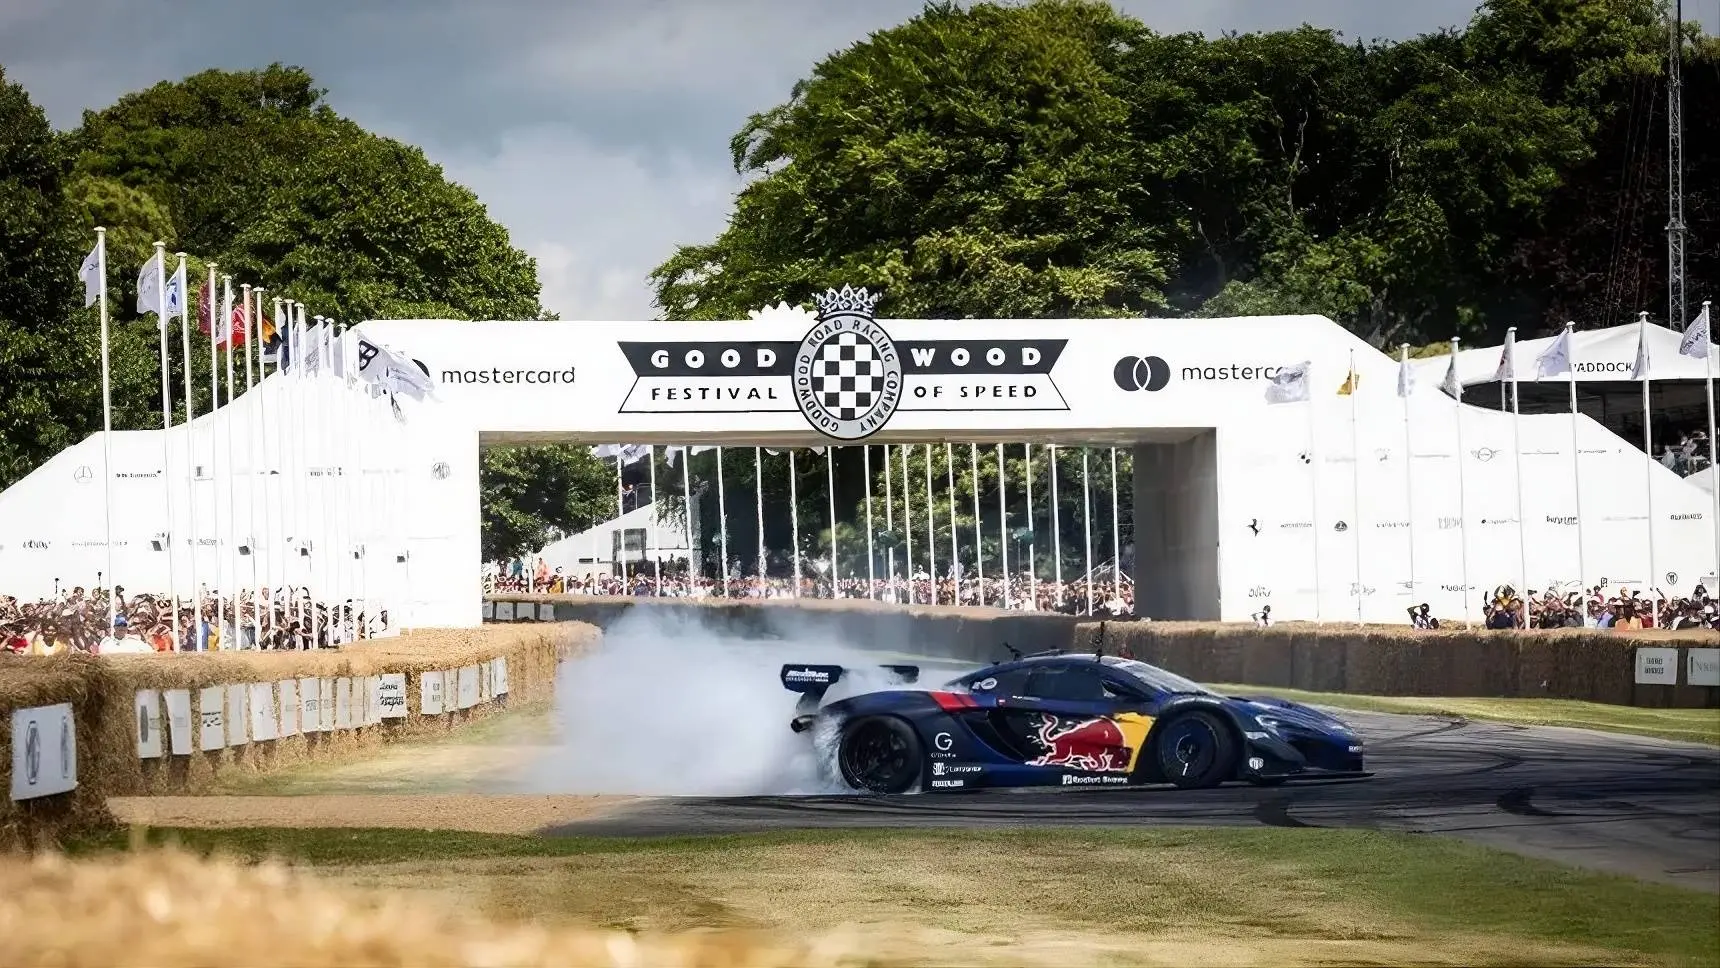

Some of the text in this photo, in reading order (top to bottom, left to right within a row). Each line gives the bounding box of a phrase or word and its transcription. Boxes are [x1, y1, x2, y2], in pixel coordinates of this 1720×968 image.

[650, 347, 1042, 369] GOOD WOOD
[441, 366, 576, 384] mastercard
[798, 320, 899, 433] GOODWOOD ROAD RACING COMPANY
[1182, 363, 1284, 381] masterc
[1573, 362, 1633, 373] ADDOCK
[651, 385, 1037, 401] FESTIVAL OF SPEED
